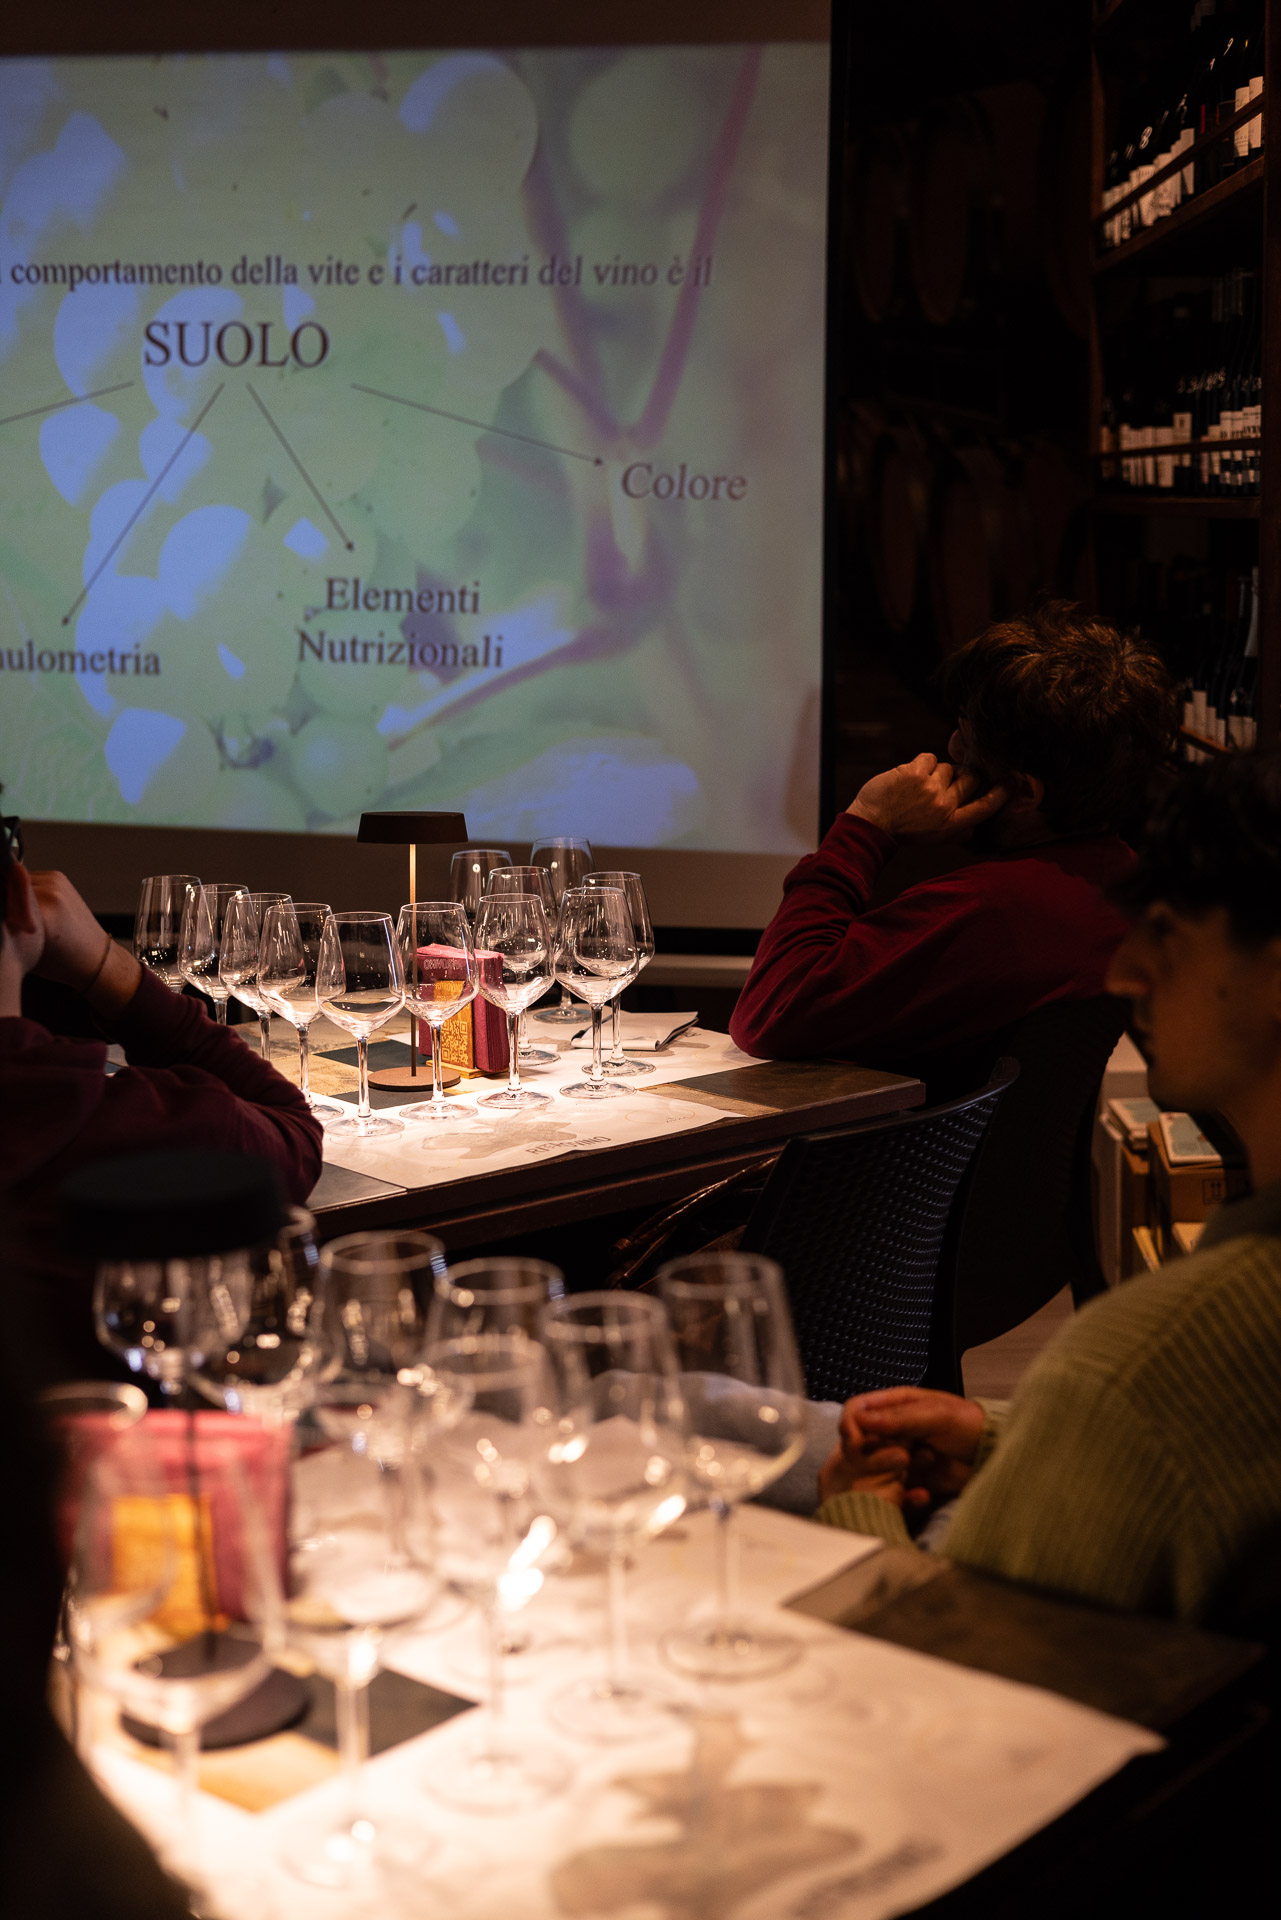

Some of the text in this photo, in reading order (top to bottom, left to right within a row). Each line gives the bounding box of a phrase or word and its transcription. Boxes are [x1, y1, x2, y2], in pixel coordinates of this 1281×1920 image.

[10, 258, 223, 292] comportamento
[231, 254, 298, 286] della
[307, 255, 360, 286] vite
[368, 262, 384, 286] e
[393, 255, 402, 286] i
[411, 255, 529, 286] caratteri
[538, 255, 583, 287] del
[593, 255, 658, 287] vino
[692, 255, 713, 287] il
[143, 320, 331, 368] SUOLO
[620, 461, 748, 501] Colore
[324, 576, 481, 614] Elementi
[0, 640, 161, 676] ulometria
[297, 629, 504, 669] Nutrizionali
